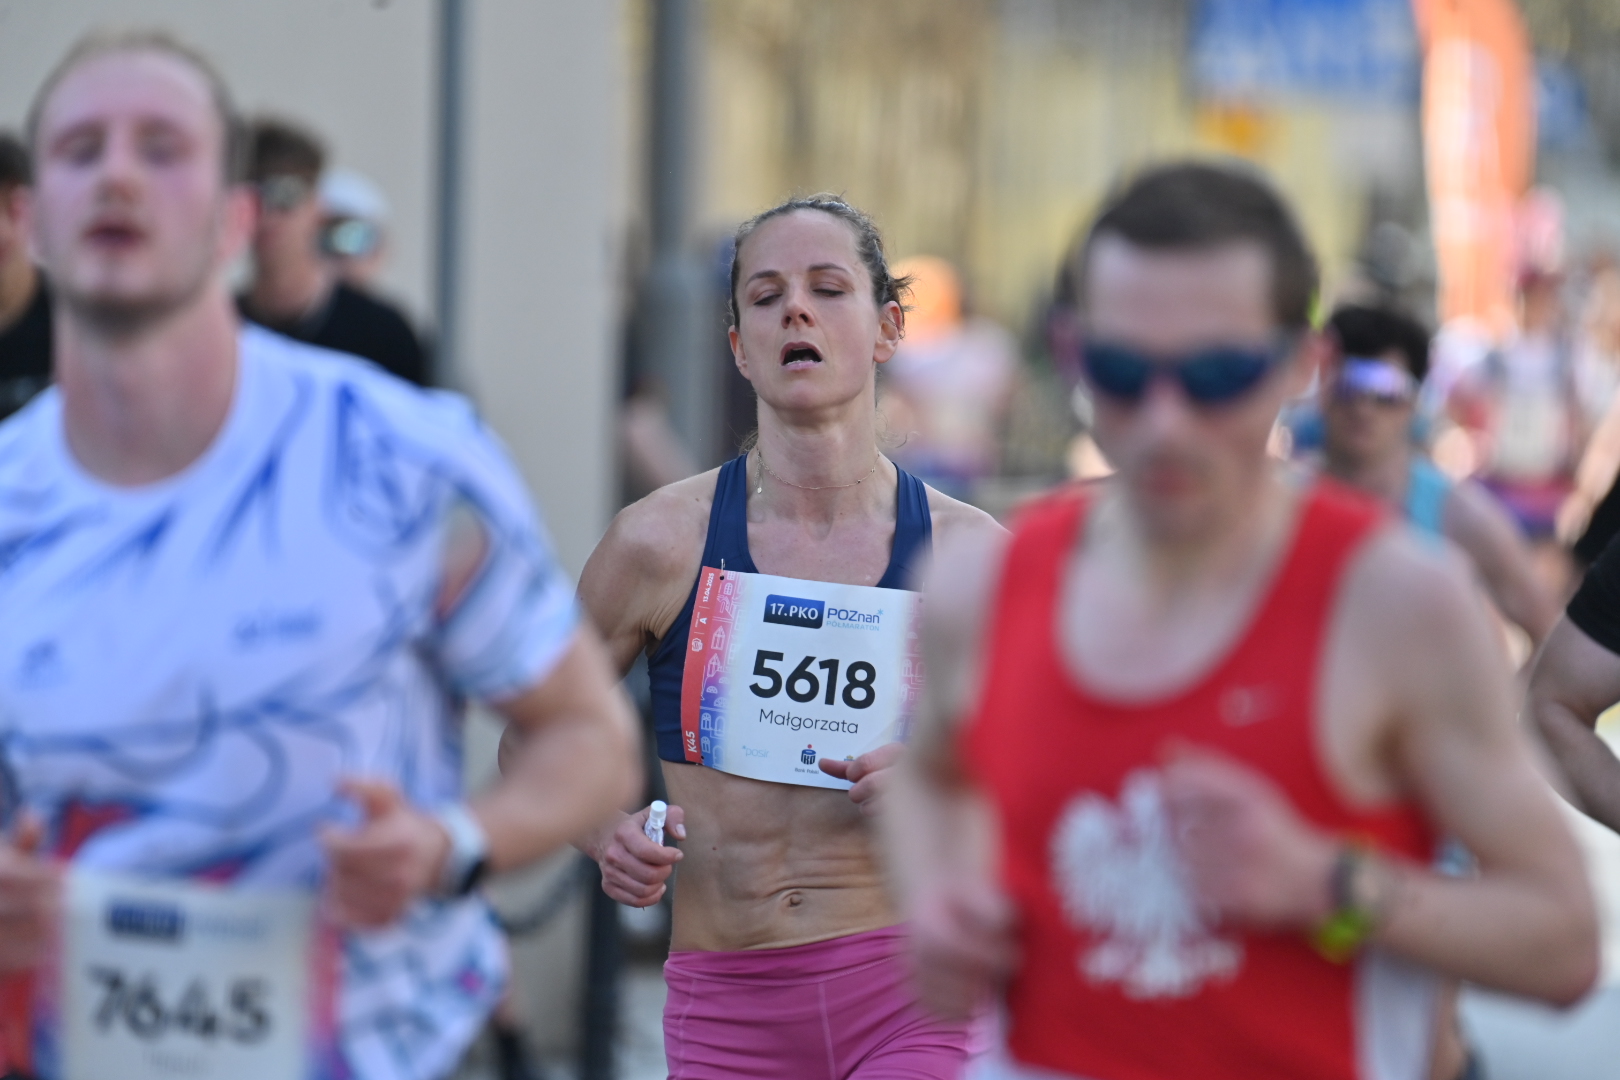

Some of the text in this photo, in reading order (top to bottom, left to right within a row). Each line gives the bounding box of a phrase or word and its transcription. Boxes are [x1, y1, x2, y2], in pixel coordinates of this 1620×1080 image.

[702, 573, 715, 603] 13.04.2025
[699, 617, 708, 625] A
[770, 603, 819, 620] 17.PKO
[826, 620, 880, 631] PÓŁMARATON
[749, 649, 877, 710] 5618
[759, 708, 858, 735] Małgorzata
[687, 731, 697, 753] K45
[88, 965, 272, 1045] 7645
